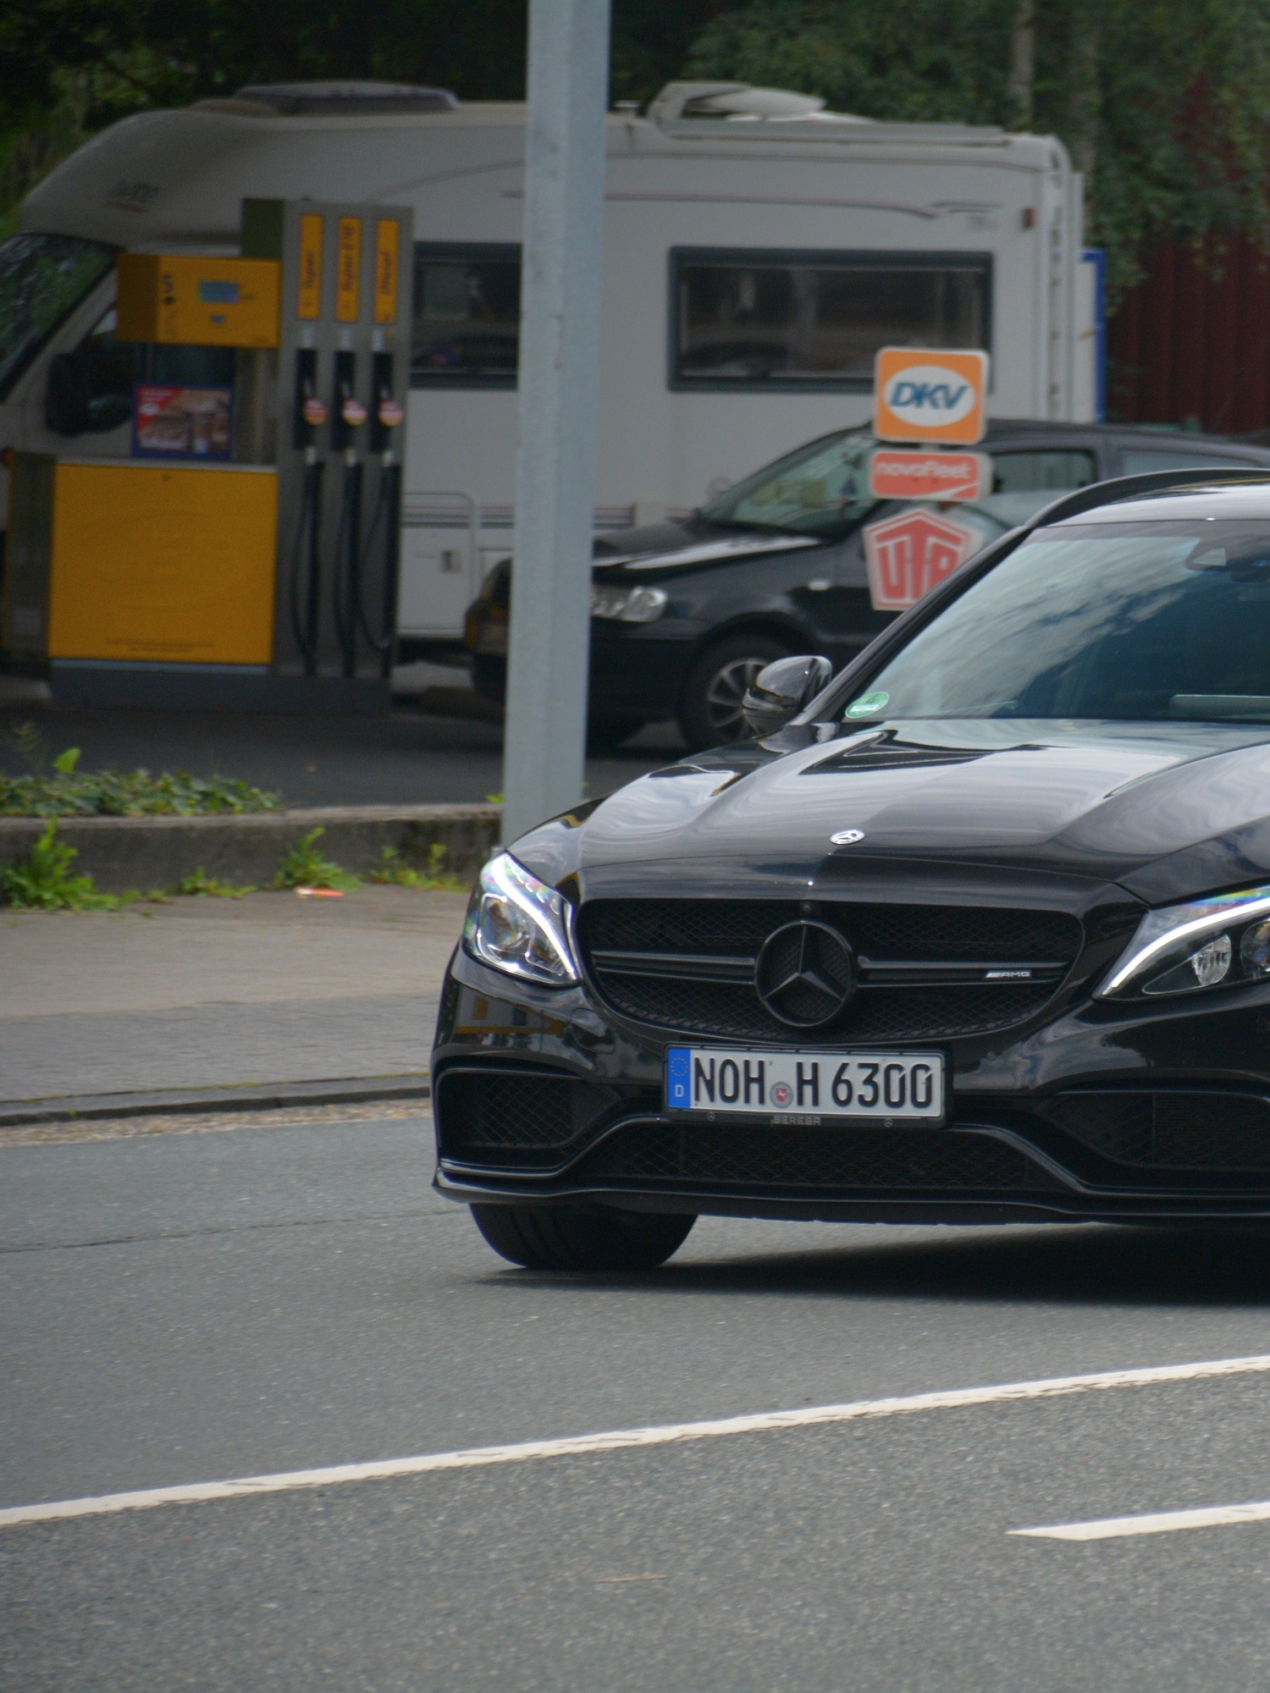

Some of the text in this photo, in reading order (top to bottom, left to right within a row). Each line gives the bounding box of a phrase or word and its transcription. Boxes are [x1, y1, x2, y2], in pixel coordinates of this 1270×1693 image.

[888, 382, 970, 410] DKV
[674, 1084, 684, 1098] D
[693, 1057, 934, 1108] NOH H 6300
